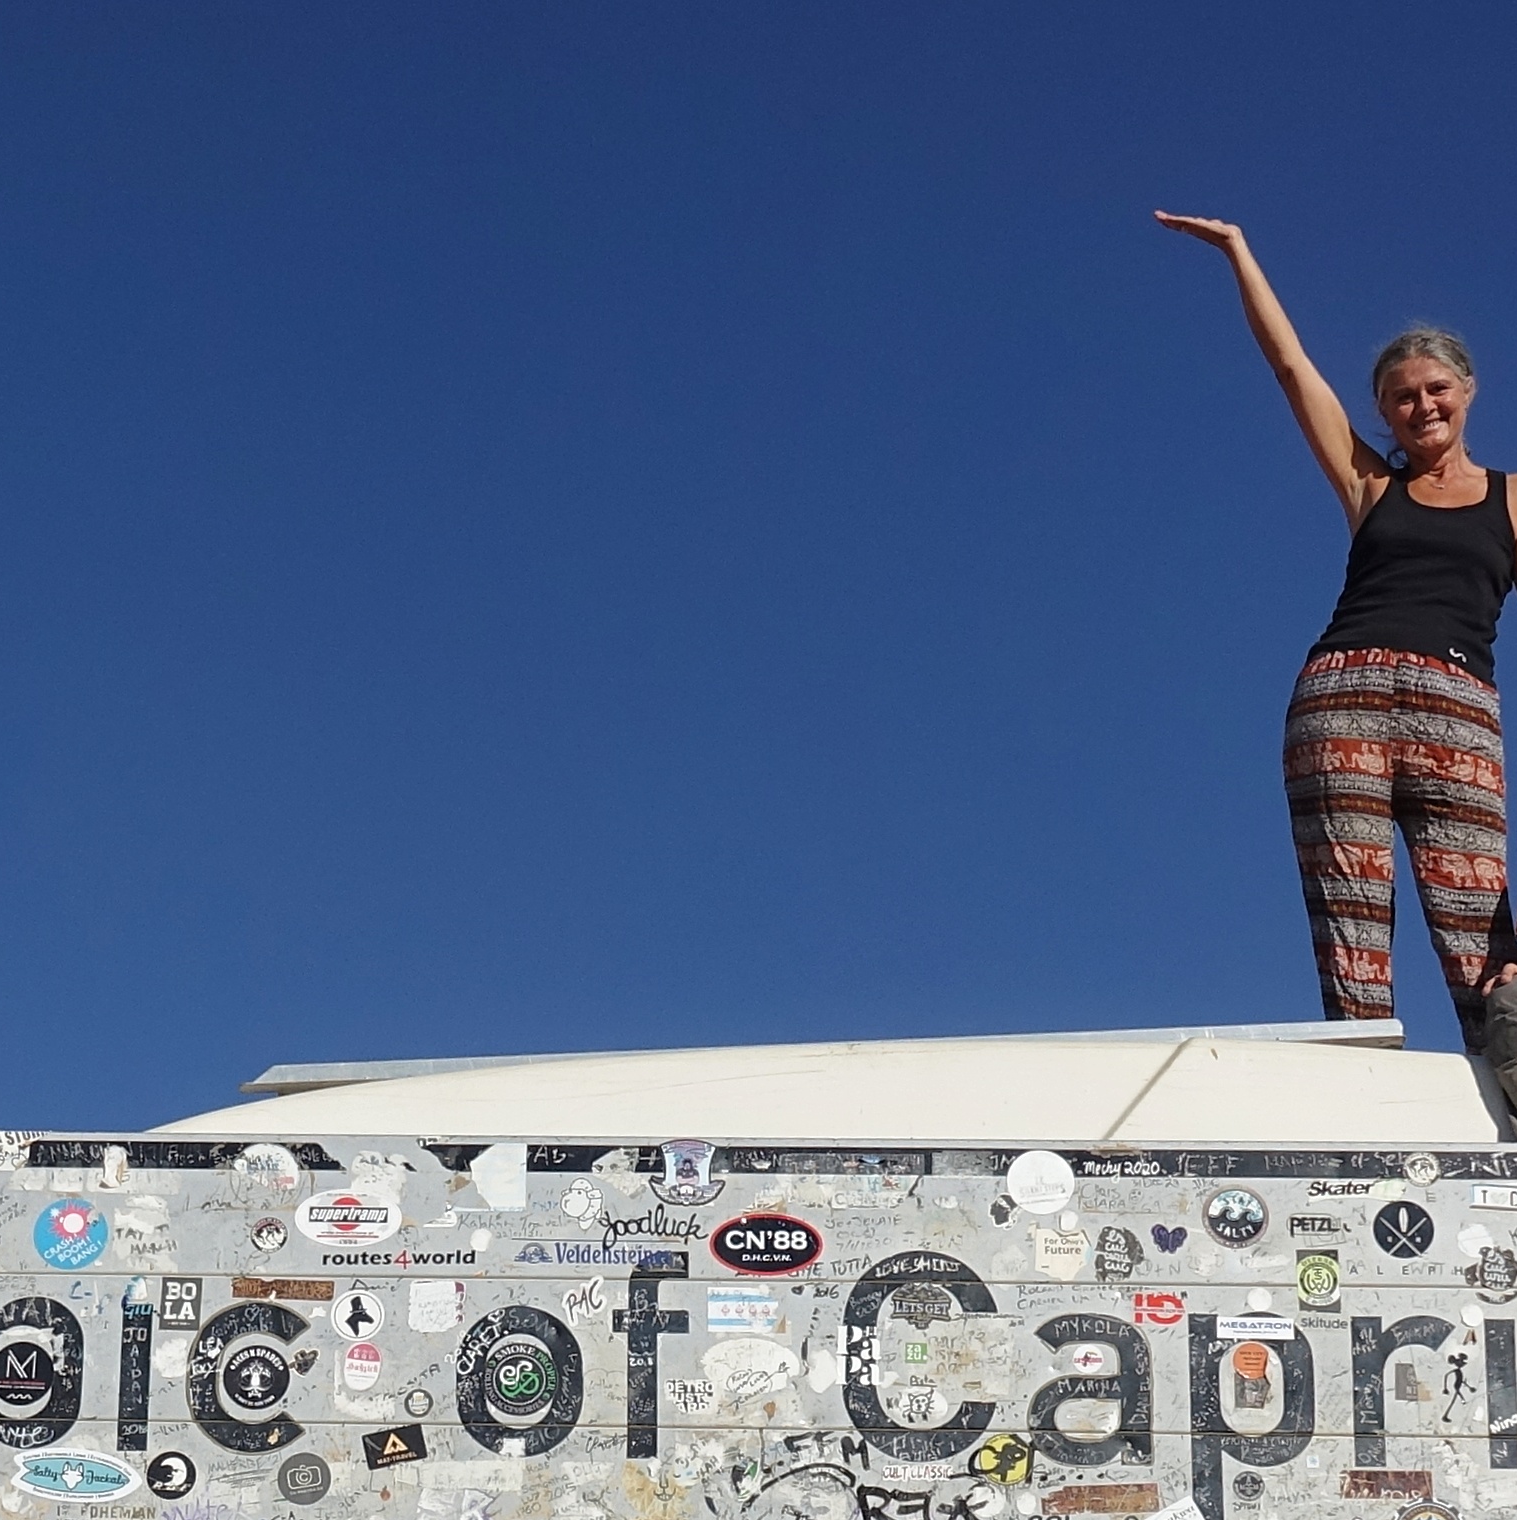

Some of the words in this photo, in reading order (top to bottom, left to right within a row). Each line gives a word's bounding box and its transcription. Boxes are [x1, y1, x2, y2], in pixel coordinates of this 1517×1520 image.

[1308, 1181, 1372, 1197] Skater
[310, 1207, 387, 1223] supertramp
[1215, 1222, 1257, 1239] SALTY
[1289, 1217, 1340, 1238] PETZL
[725, 1230, 808, 1250] CN'88
[1044, 1237, 1058, 1245] For
[322, 1250, 476, 1269] routes4world
[1044, 1246, 1082, 1255] Future
[165, 1281, 197, 1301] BO
[163, 1302, 196, 1320] LA
[1219, 1320, 1293, 1331] MEGATRON
[1300, 1317, 1348, 1330] Skitude
[455, 1249, 690, 1460] of
[495, 1345, 536, 1361] SMOKE
[536, 1351, 557, 1391] PROPER
[33, 1465, 59, 1482] Salty
[85, 1469, 124, 1485] Jackal
